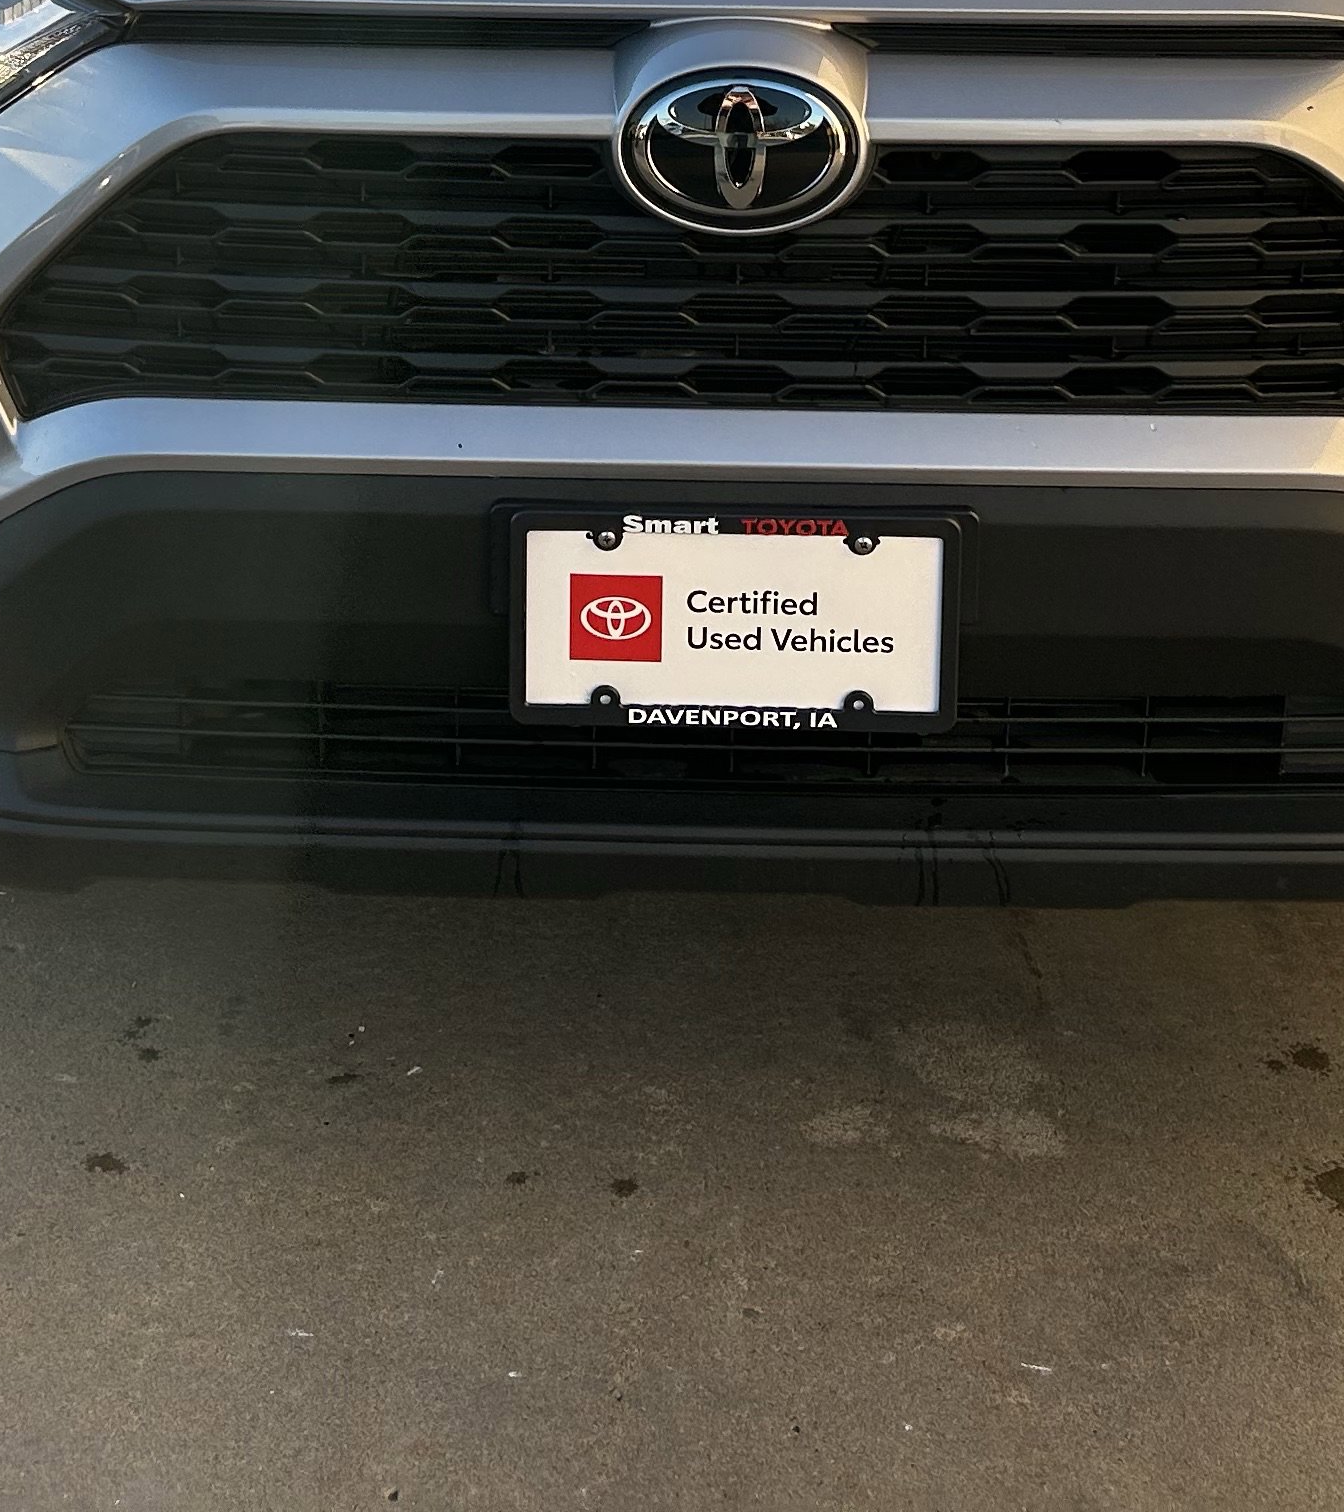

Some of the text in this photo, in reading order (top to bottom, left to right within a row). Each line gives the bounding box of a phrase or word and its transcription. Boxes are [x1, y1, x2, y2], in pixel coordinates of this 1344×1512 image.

[622, 514, 850, 537] Smart TOYOTA
[686, 590, 819, 617] Certified
[686, 626, 895, 654] Used Vehicles
[628, 708, 838, 729] DAVENPORT, IA
